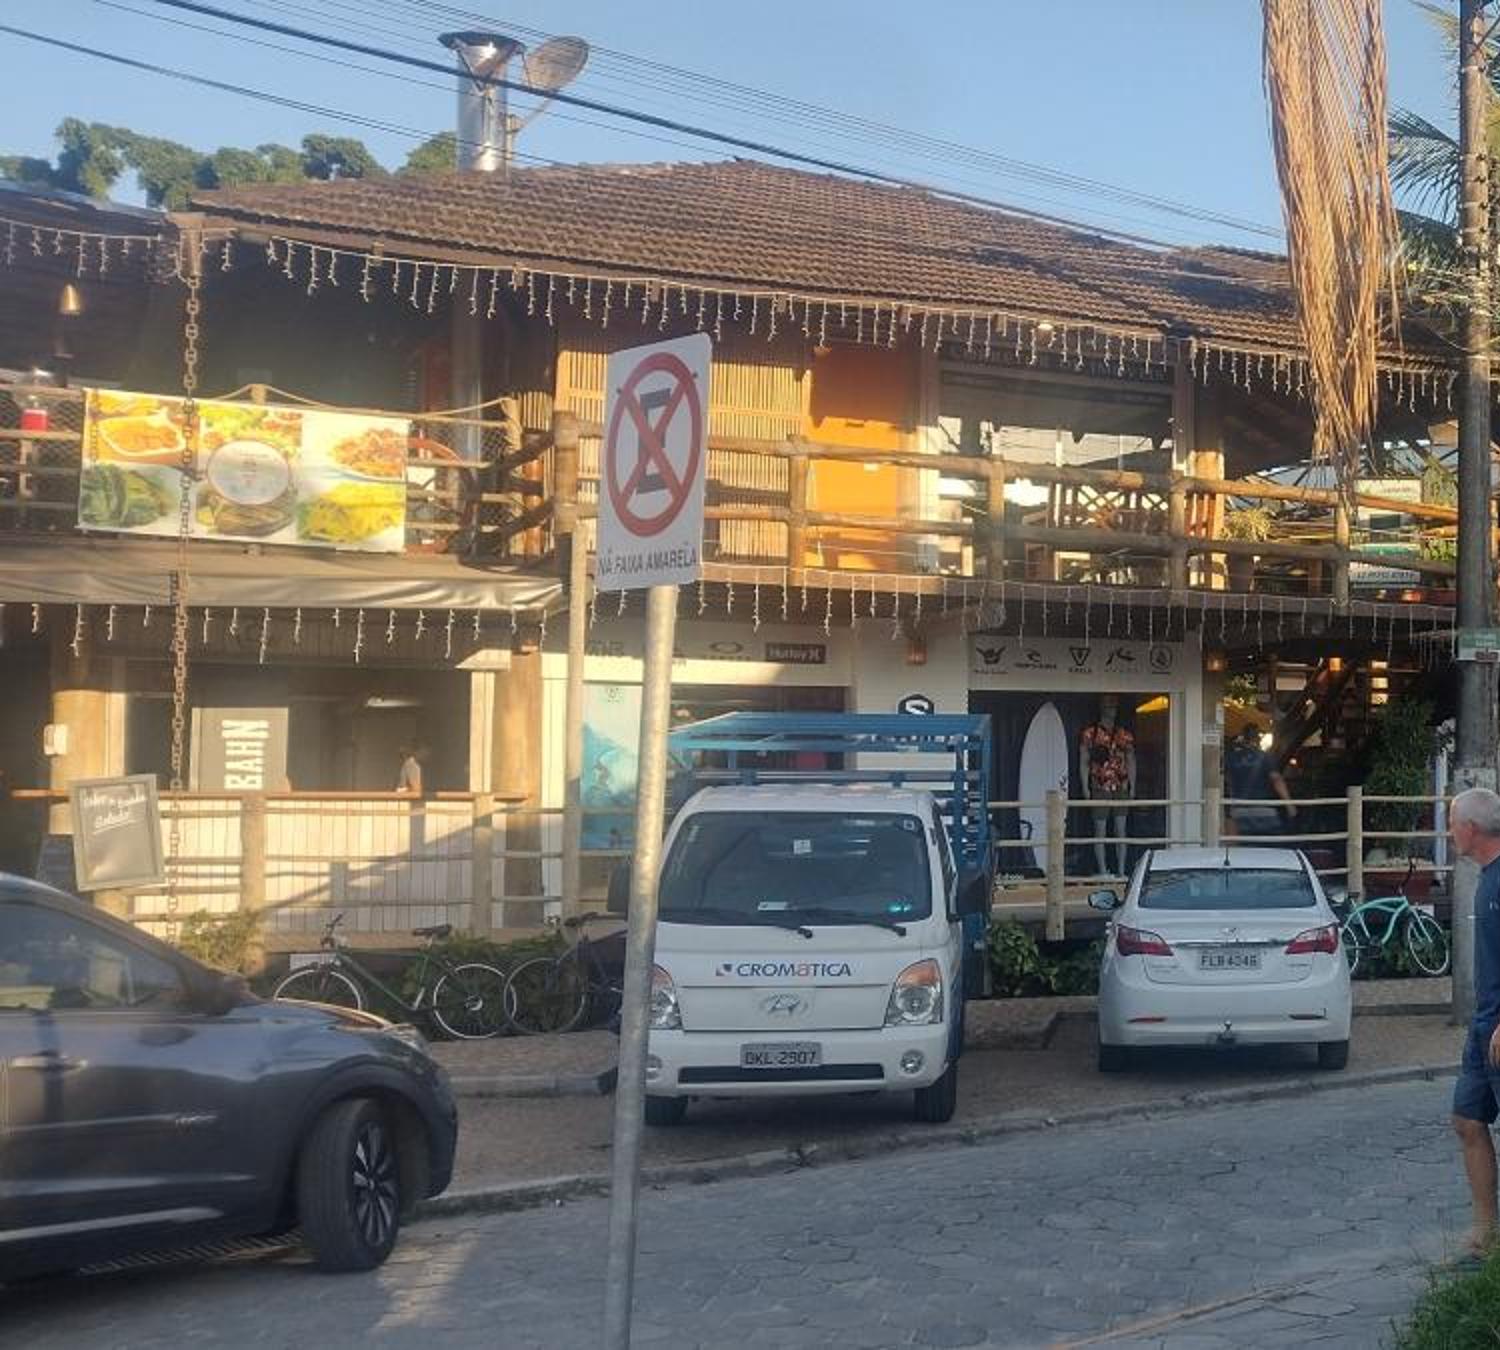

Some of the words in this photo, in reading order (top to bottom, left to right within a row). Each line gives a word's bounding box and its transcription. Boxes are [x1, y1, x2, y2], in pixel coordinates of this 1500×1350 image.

[614, 552, 642, 574] FAIXA
[644, 546, 697, 572] AMARELA
[222, 719, 269, 790] BAHN
